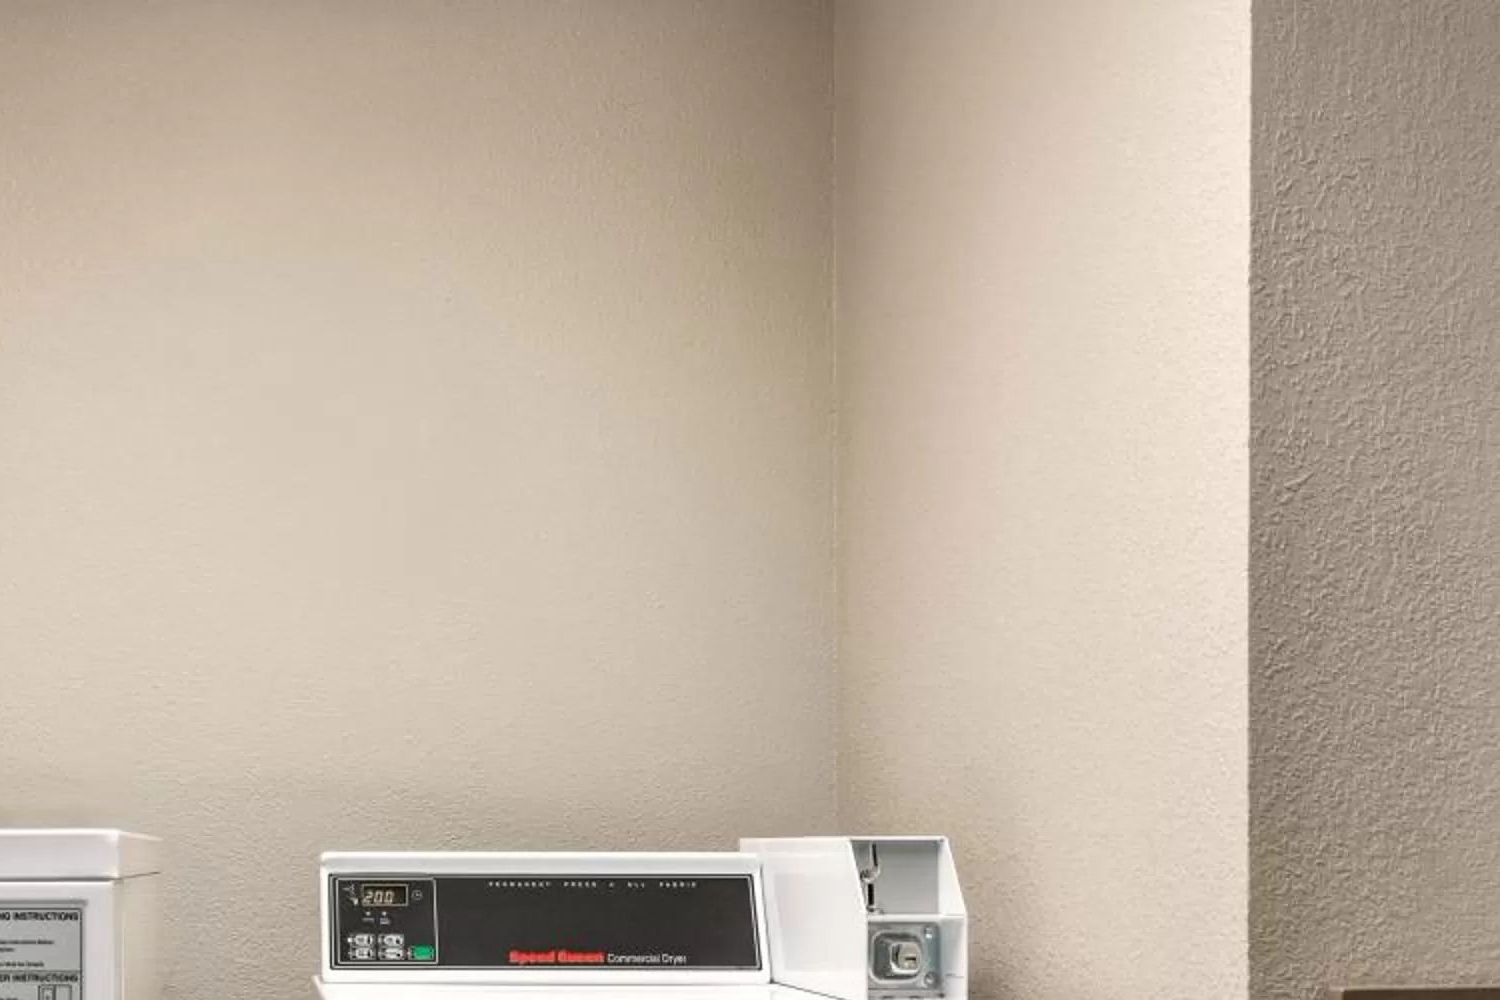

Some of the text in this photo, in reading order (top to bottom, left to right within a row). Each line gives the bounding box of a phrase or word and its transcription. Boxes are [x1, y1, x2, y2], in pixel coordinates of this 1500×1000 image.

[361, 890, 394, 904] 200
[12, 911, 79, 921] INSTRUCTIONS
[607, 952, 660, 964] Commercial
[662, 952, 687, 965] Dryer
[12, 973, 79, 982] INSTRUCTIONS
